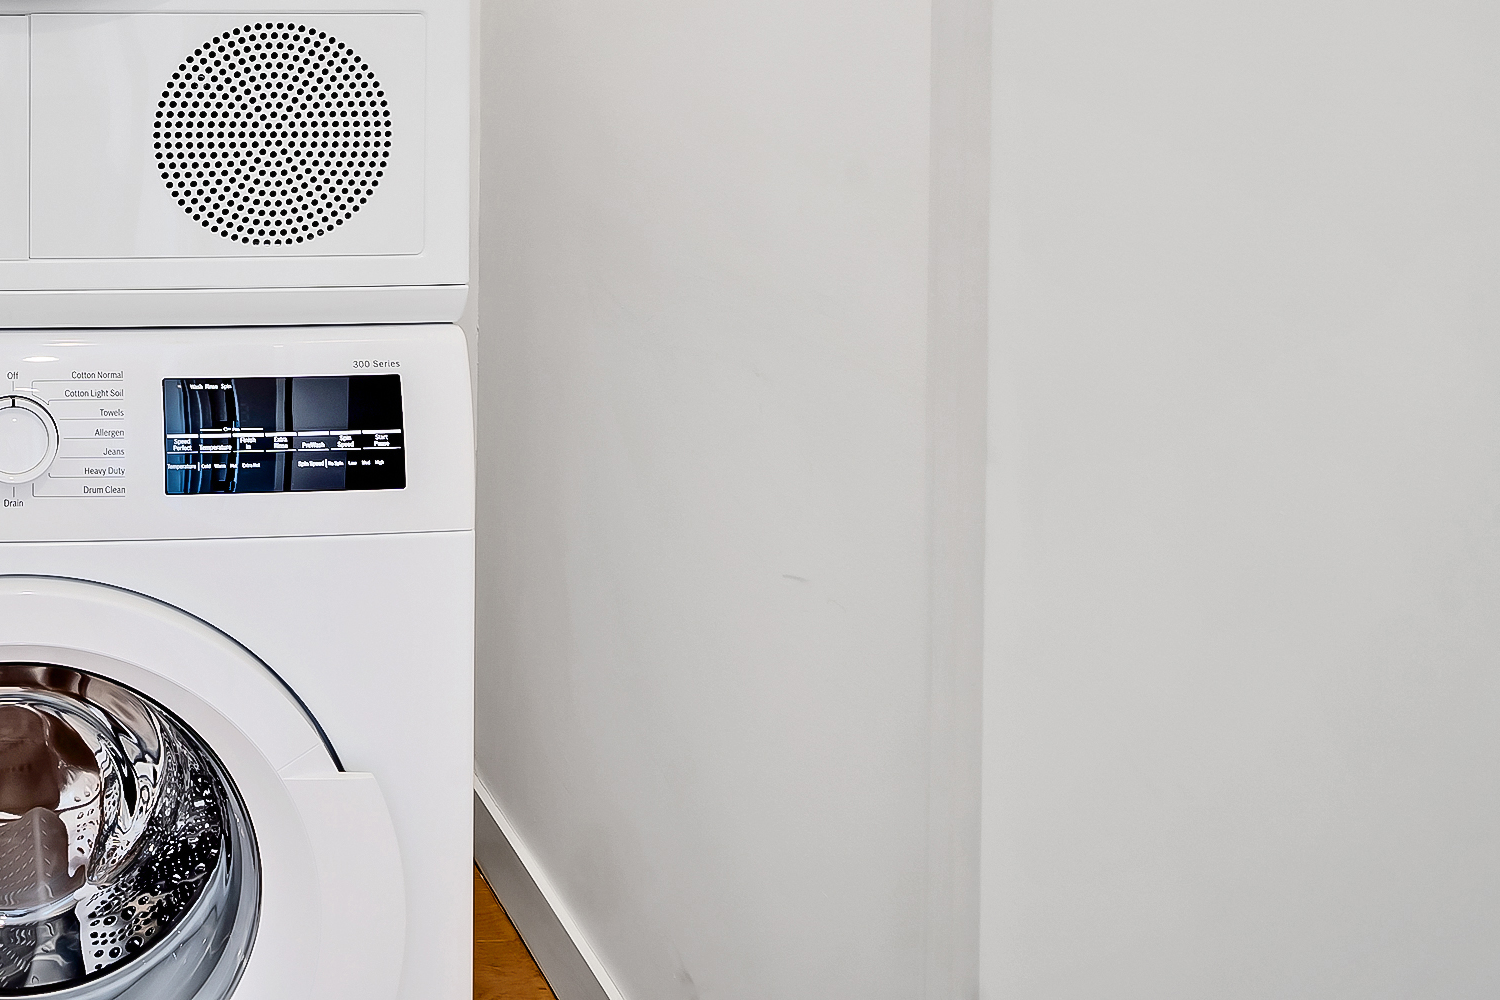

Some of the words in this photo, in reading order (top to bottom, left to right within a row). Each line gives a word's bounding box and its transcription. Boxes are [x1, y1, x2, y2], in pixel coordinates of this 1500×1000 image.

[352, 360, 371, 369] 300
[372, 359, 401, 368] Series
[6, 371, 19, 380] Off
[71, 371, 96, 379] Cotton
[97, 370, 124, 379] Normal
[64, 389, 90, 398] Cotton
[90, 389, 109, 399] Light
[109, 388, 124, 397] Soil
[100, 408, 125, 417] Towels
[94, 428, 125, 438] Allergen
[103, 448, 125, 456] Jeans
[84, 467, 107, 476] Heavy
[107, 466, 126, 475] Duty
[83, 485, 104, 494] Drum
[104, 485, 126, 494] Clean
[3, 499, 24, 508] Drain
